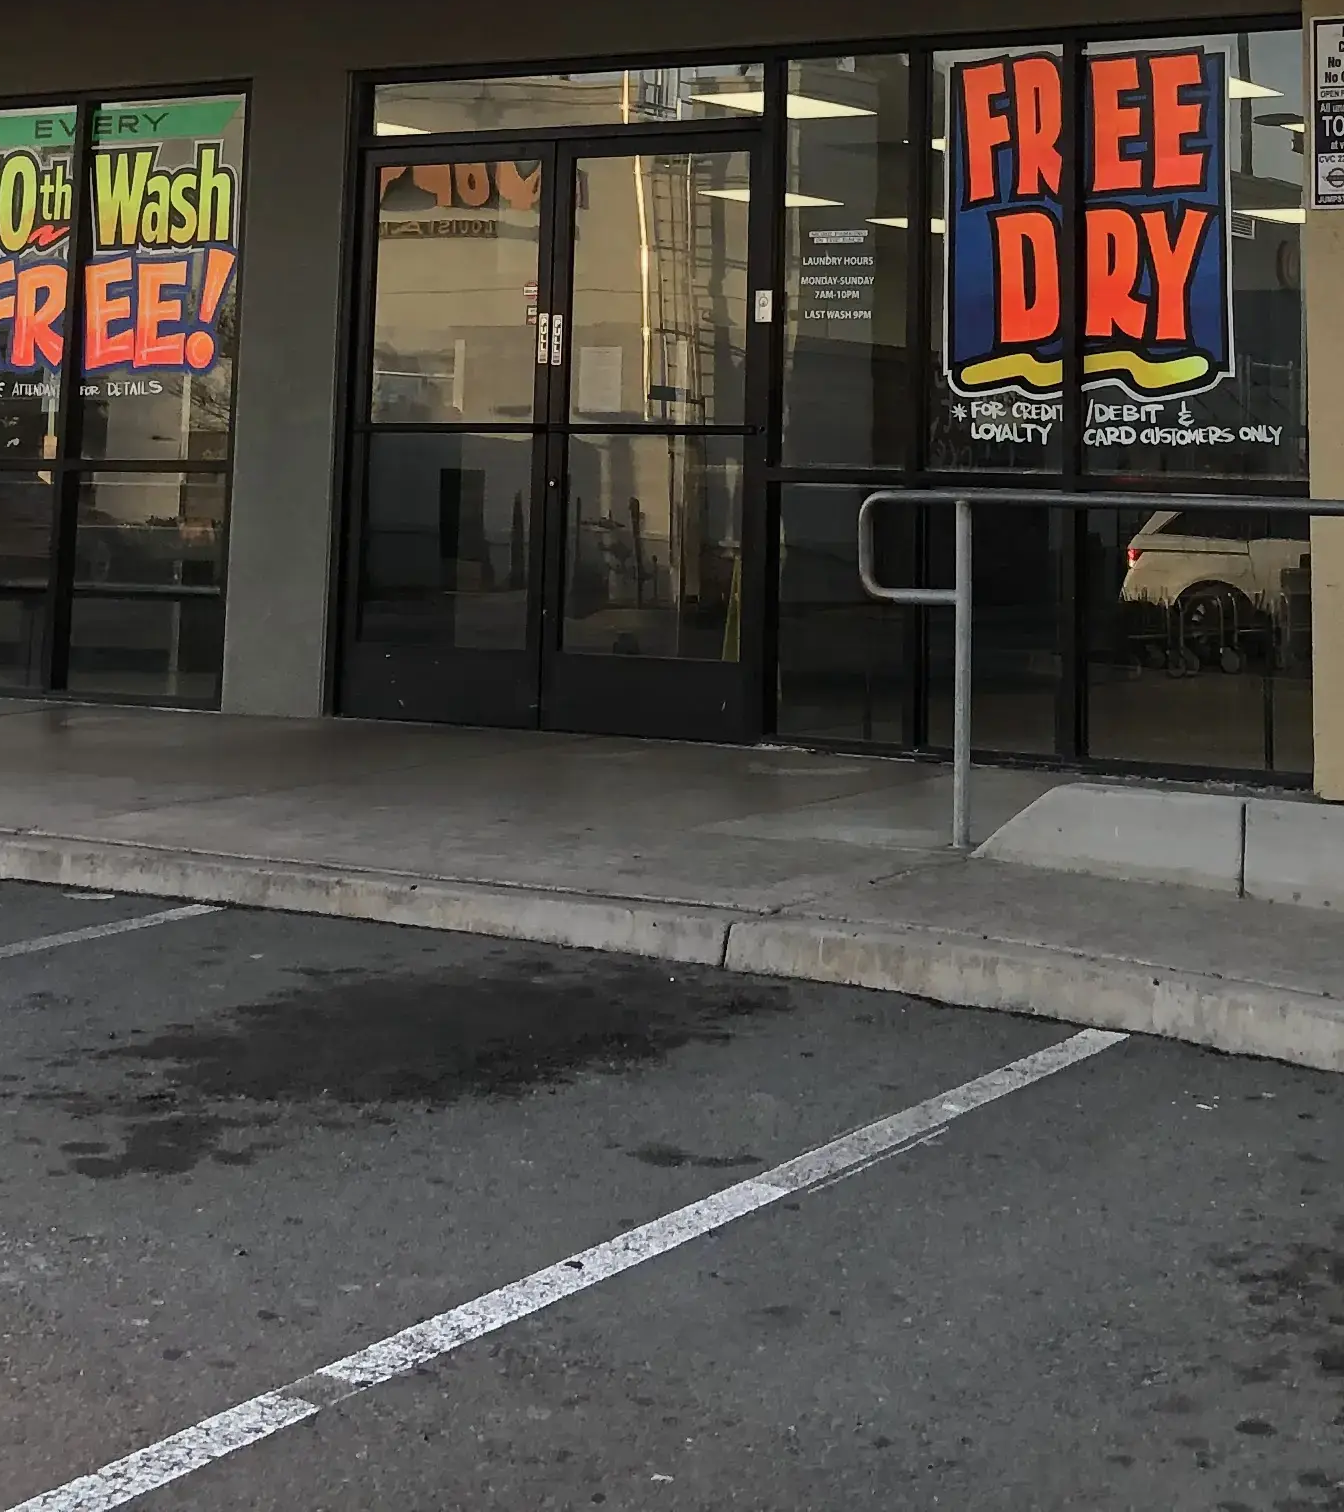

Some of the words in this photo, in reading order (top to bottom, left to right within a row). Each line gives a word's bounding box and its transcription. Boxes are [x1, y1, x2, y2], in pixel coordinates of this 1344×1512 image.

[1327, 56, 1341, 68] No
[1324, 71, 1338, 83] No
[1320, 89, 1339, 98] OPEN
[1320, 103, 1331, 113] All
[34, 112, 169, 139] EVERY
[962, 54, 1204, 202] FREE
[1330, 140, 1338, 149] at
[1318, 155, 1335, 163] CVC
[95, 149, 231, 246] Wash
[802, 256, 843, 266] LAUNDRY
[843, 256, 874, 266] HOURS
[800, 276, 875, 285] MONDAY-SUNDAY
[995, 208, 1208, 343] DRY
[814, 290, 860, 299] 7AM-10PM
[804, 310, 826, 319] LAST
[826, 310, 852, 319] WASH
[852, 310, 872, 319] 9PM
[554, 319, 562, 353] PULL
[79, 385, 100, 395] FOR
[107, 380, 163, 397] DETAILS
[971, 401, 1006, 419] FOR
[1012, 401, 1064, 422] CREDIT
[970, 422, 1053, 445] LOYALTY
[1083, 426, 1137, 446] CARD
[1140, 426, 1235, 446] CUSTOMERS
[1239, 425, 1283, 446] ONLY
